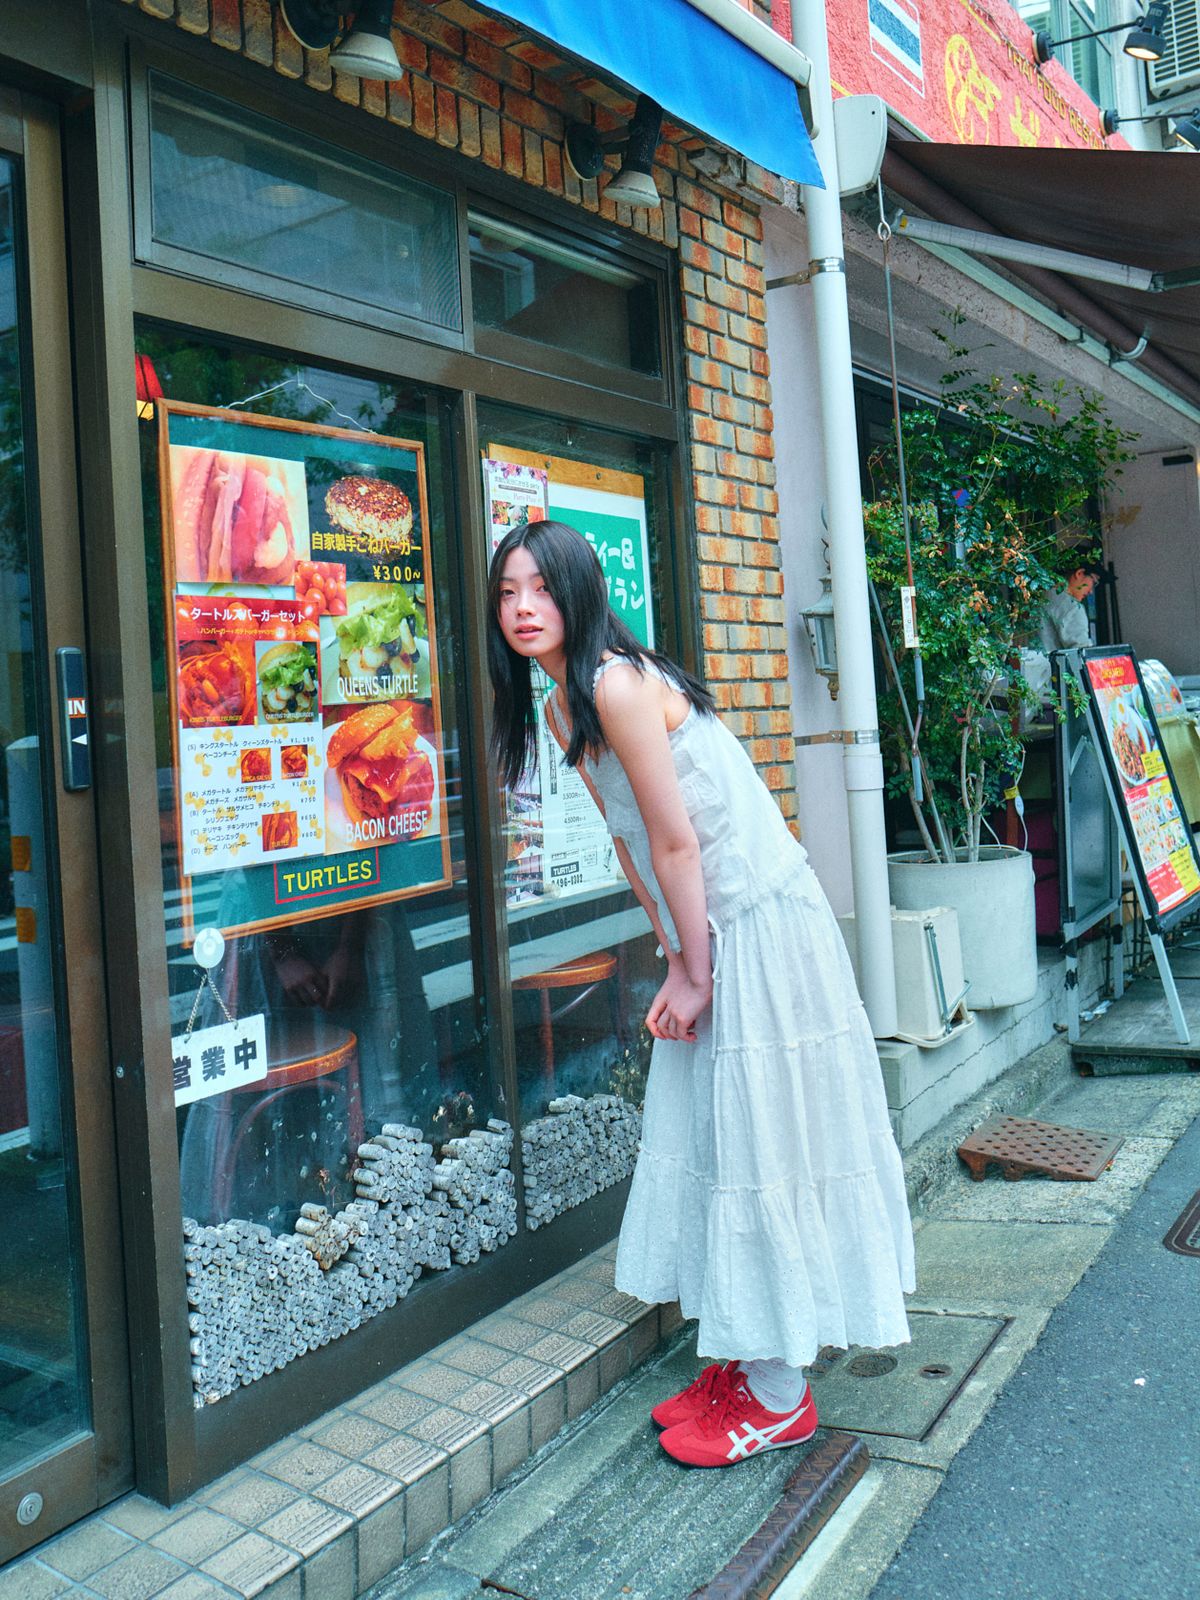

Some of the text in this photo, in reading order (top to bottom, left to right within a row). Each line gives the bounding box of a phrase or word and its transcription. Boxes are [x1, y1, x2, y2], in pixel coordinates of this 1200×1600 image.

[1007, 42, 1034, 86] THAI
[1037, 73, 1067, 120] FOOD
[311, 531, 422, 556] 自家製手ごねバーガー
[337, 674, 418, 697] QUEENS TURTLE
[67, 699, 87, 716] IN
[346, 810, 428, 843] BACON CHEESE
[283, 859, 372, 893] TURTLES
[172, 1037, 257, 1091] 営業中
